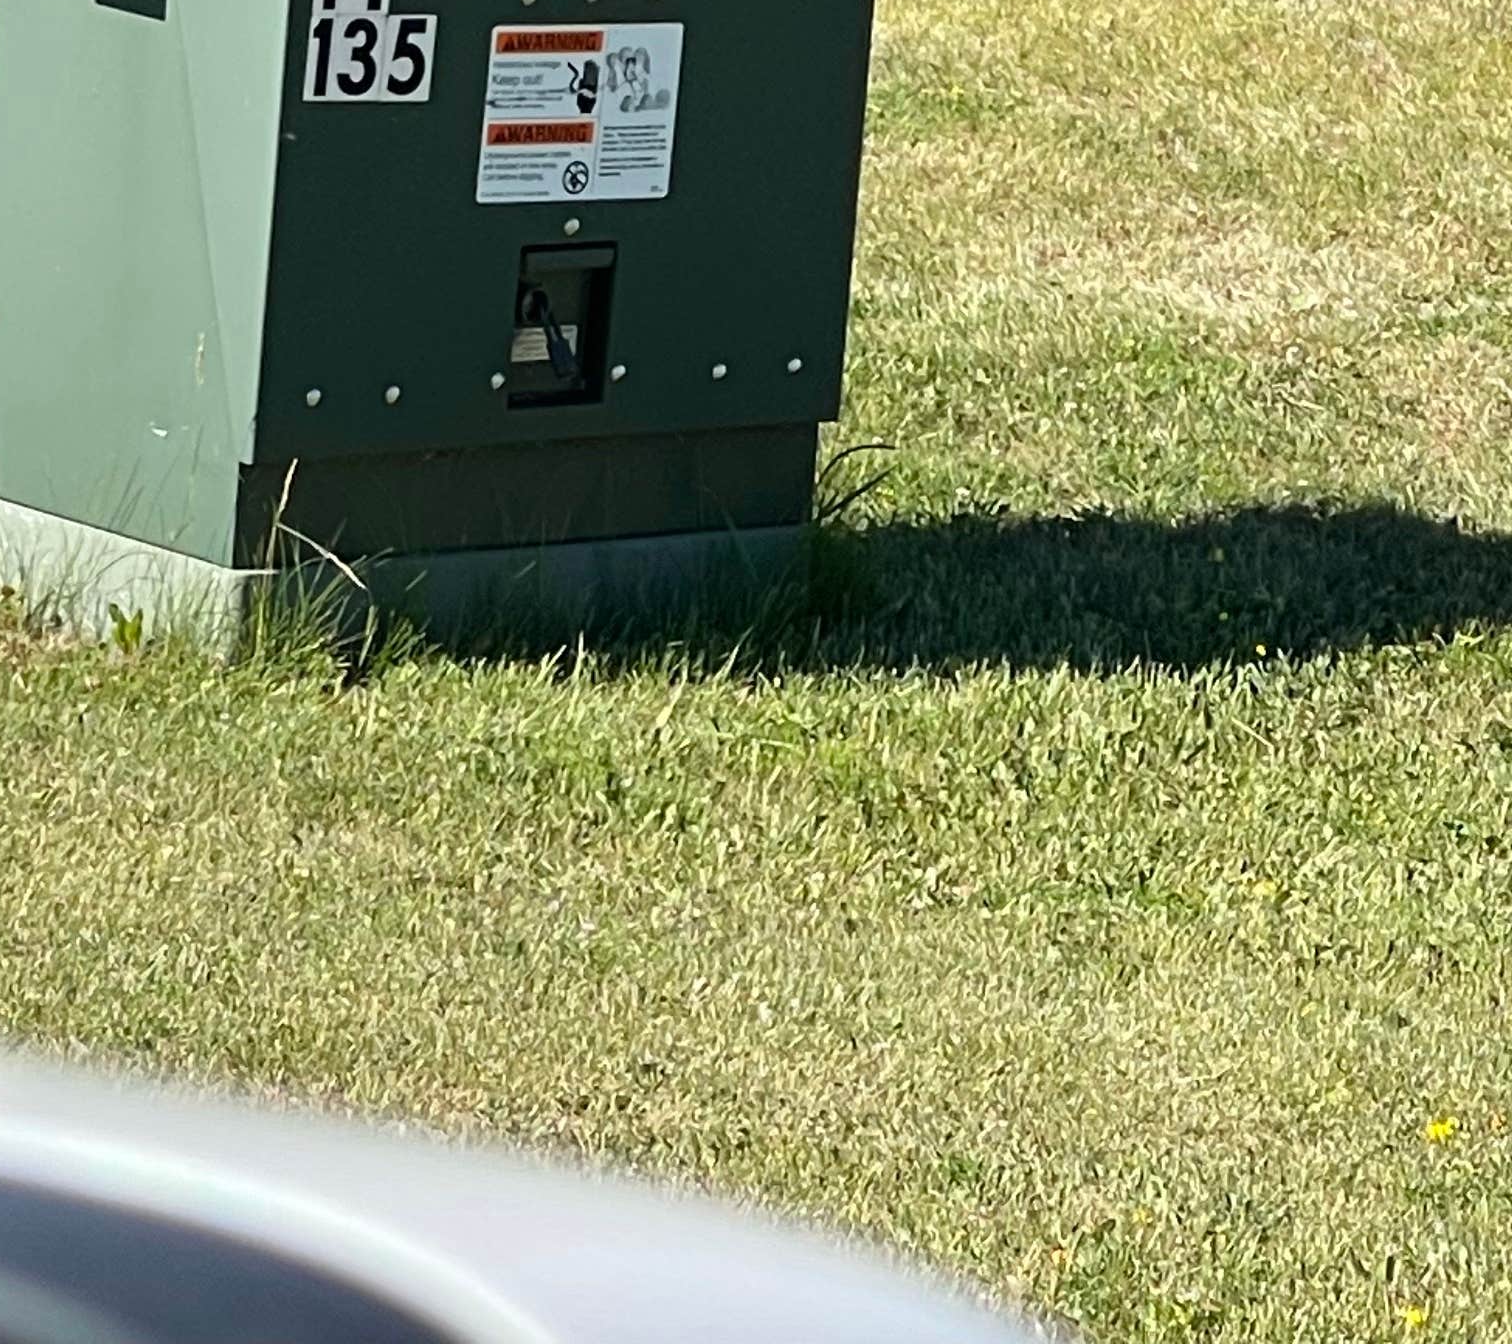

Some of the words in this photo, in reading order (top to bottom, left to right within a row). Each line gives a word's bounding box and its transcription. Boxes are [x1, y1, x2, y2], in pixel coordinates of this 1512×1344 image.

[516, 32, 599, 51] WARNING
[312, 17, 428, 97] 135
[506, 124, 589, 144] WARNING
